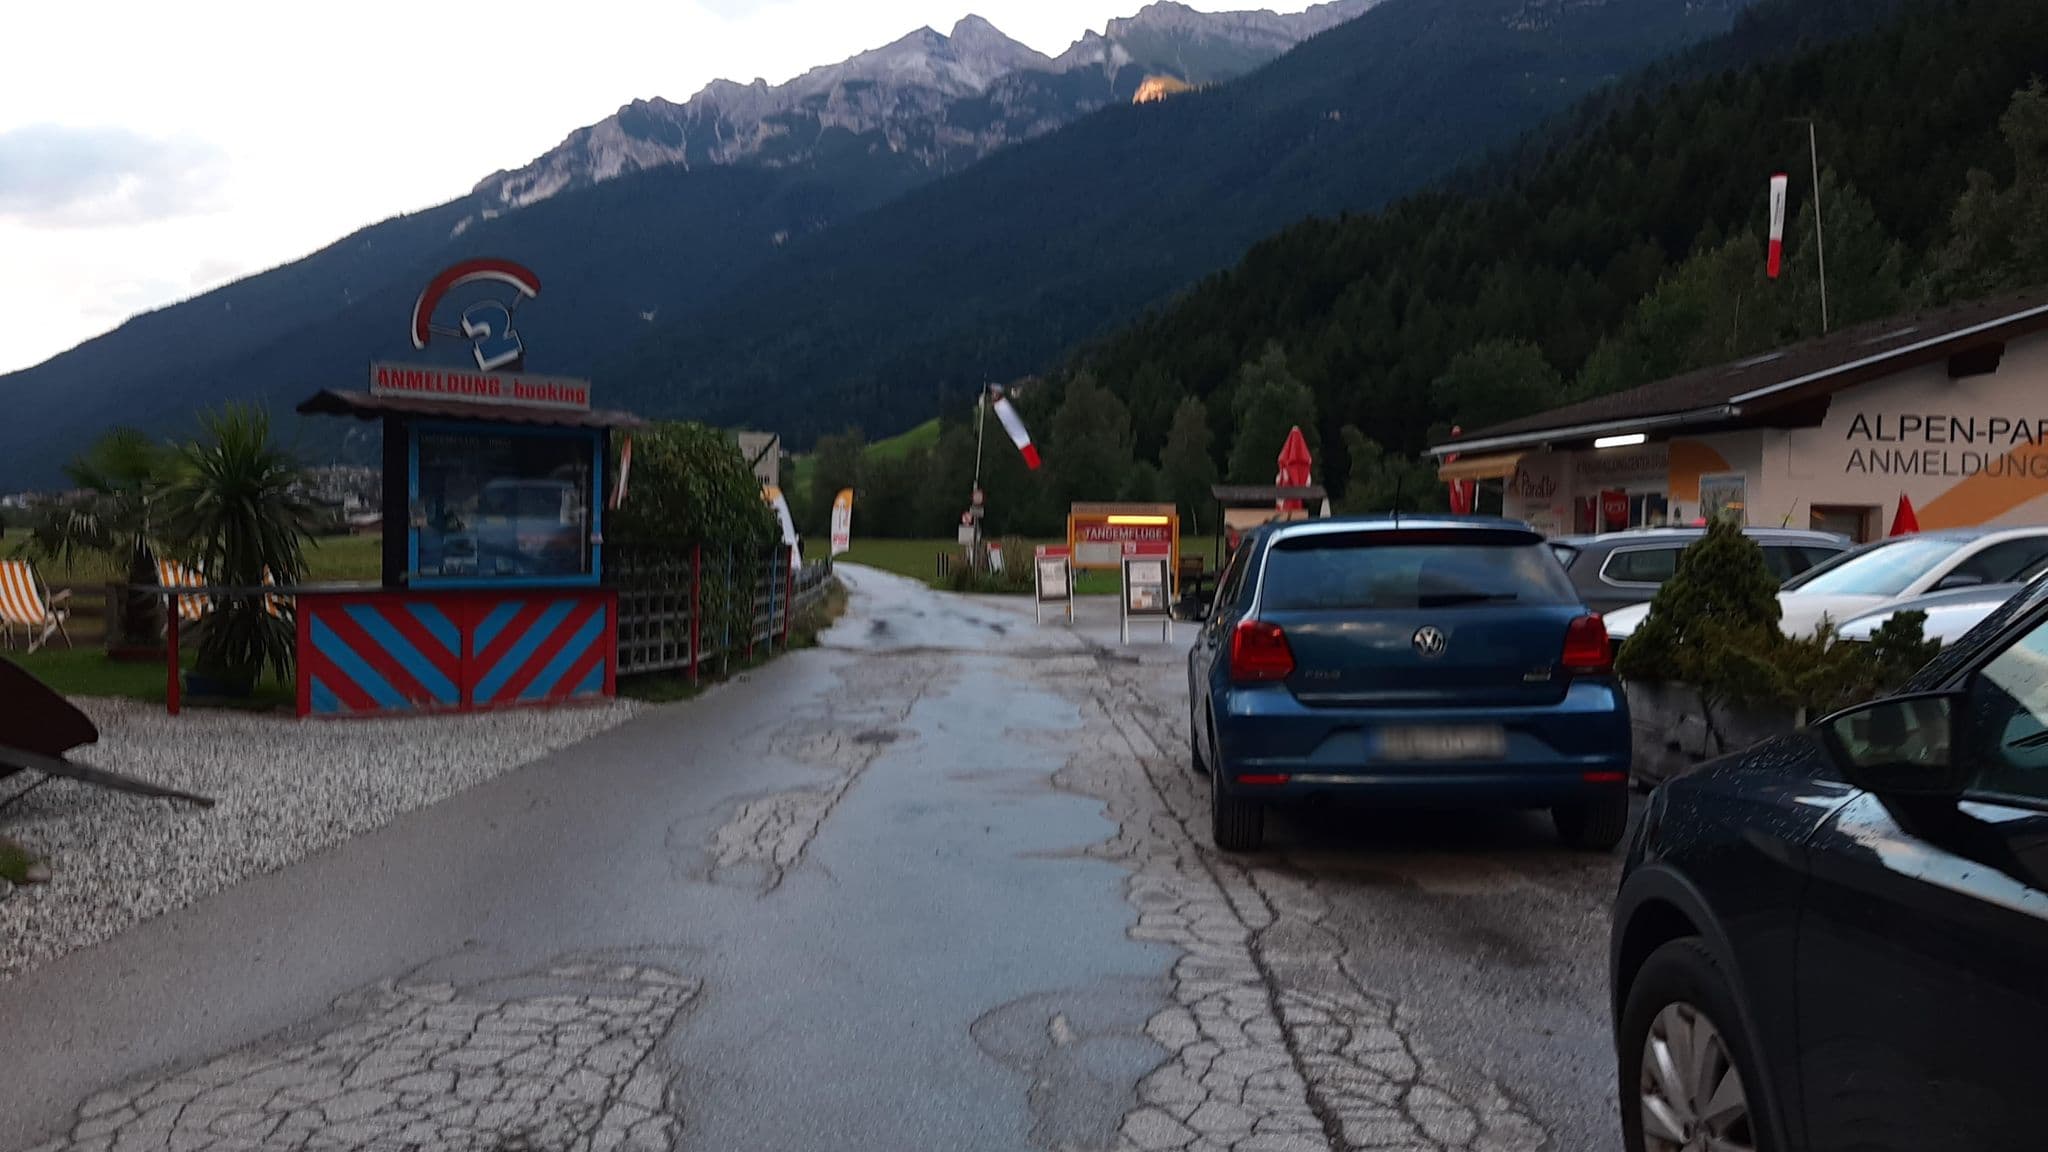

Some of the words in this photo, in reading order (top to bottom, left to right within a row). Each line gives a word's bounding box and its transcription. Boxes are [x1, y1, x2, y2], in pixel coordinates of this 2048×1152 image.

[378, 367, 501, 397] ANMELDUNG
[513, 377, 586, 405] booking
[1845, 447, 2048, 479] ANMELDUNG
